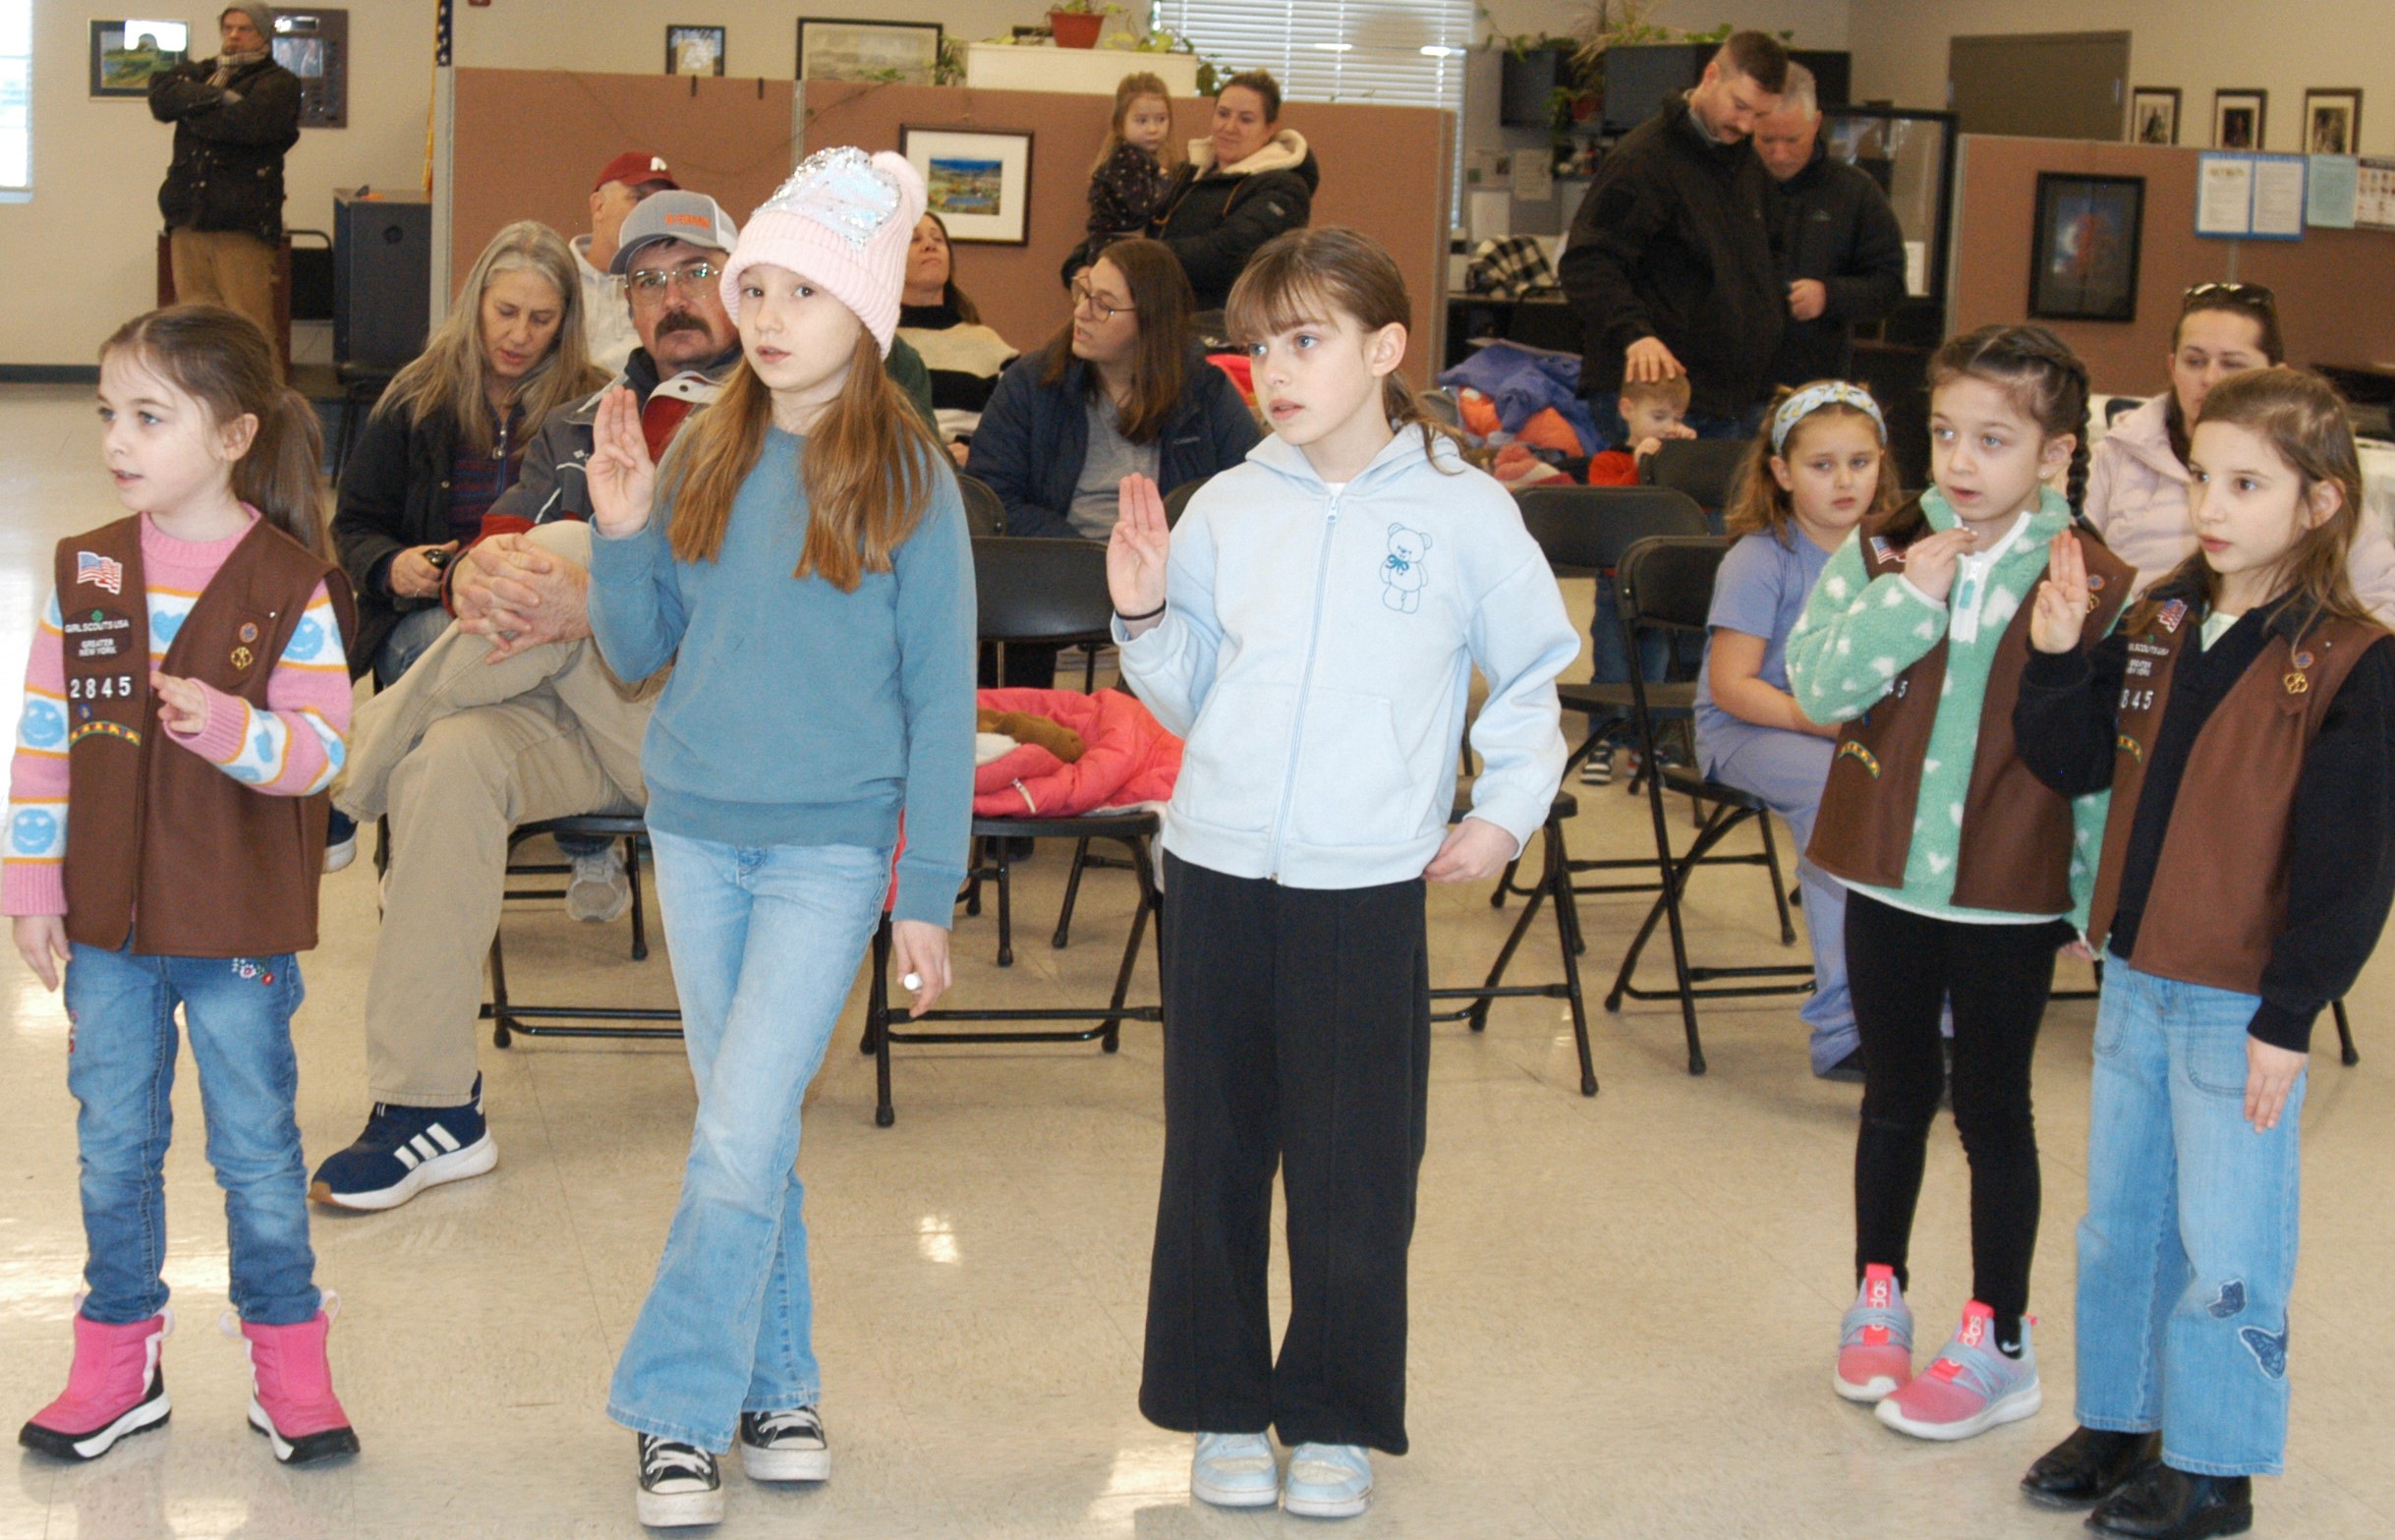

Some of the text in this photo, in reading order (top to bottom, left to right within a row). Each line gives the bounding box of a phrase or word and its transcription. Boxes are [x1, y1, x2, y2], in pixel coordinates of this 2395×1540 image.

[83, 621, 112, 632] SCOUTS
[112, 619, 129, 629] USA
[70, 676, 132, 699] 2845
[2121, 689, 2153, 710] 845
